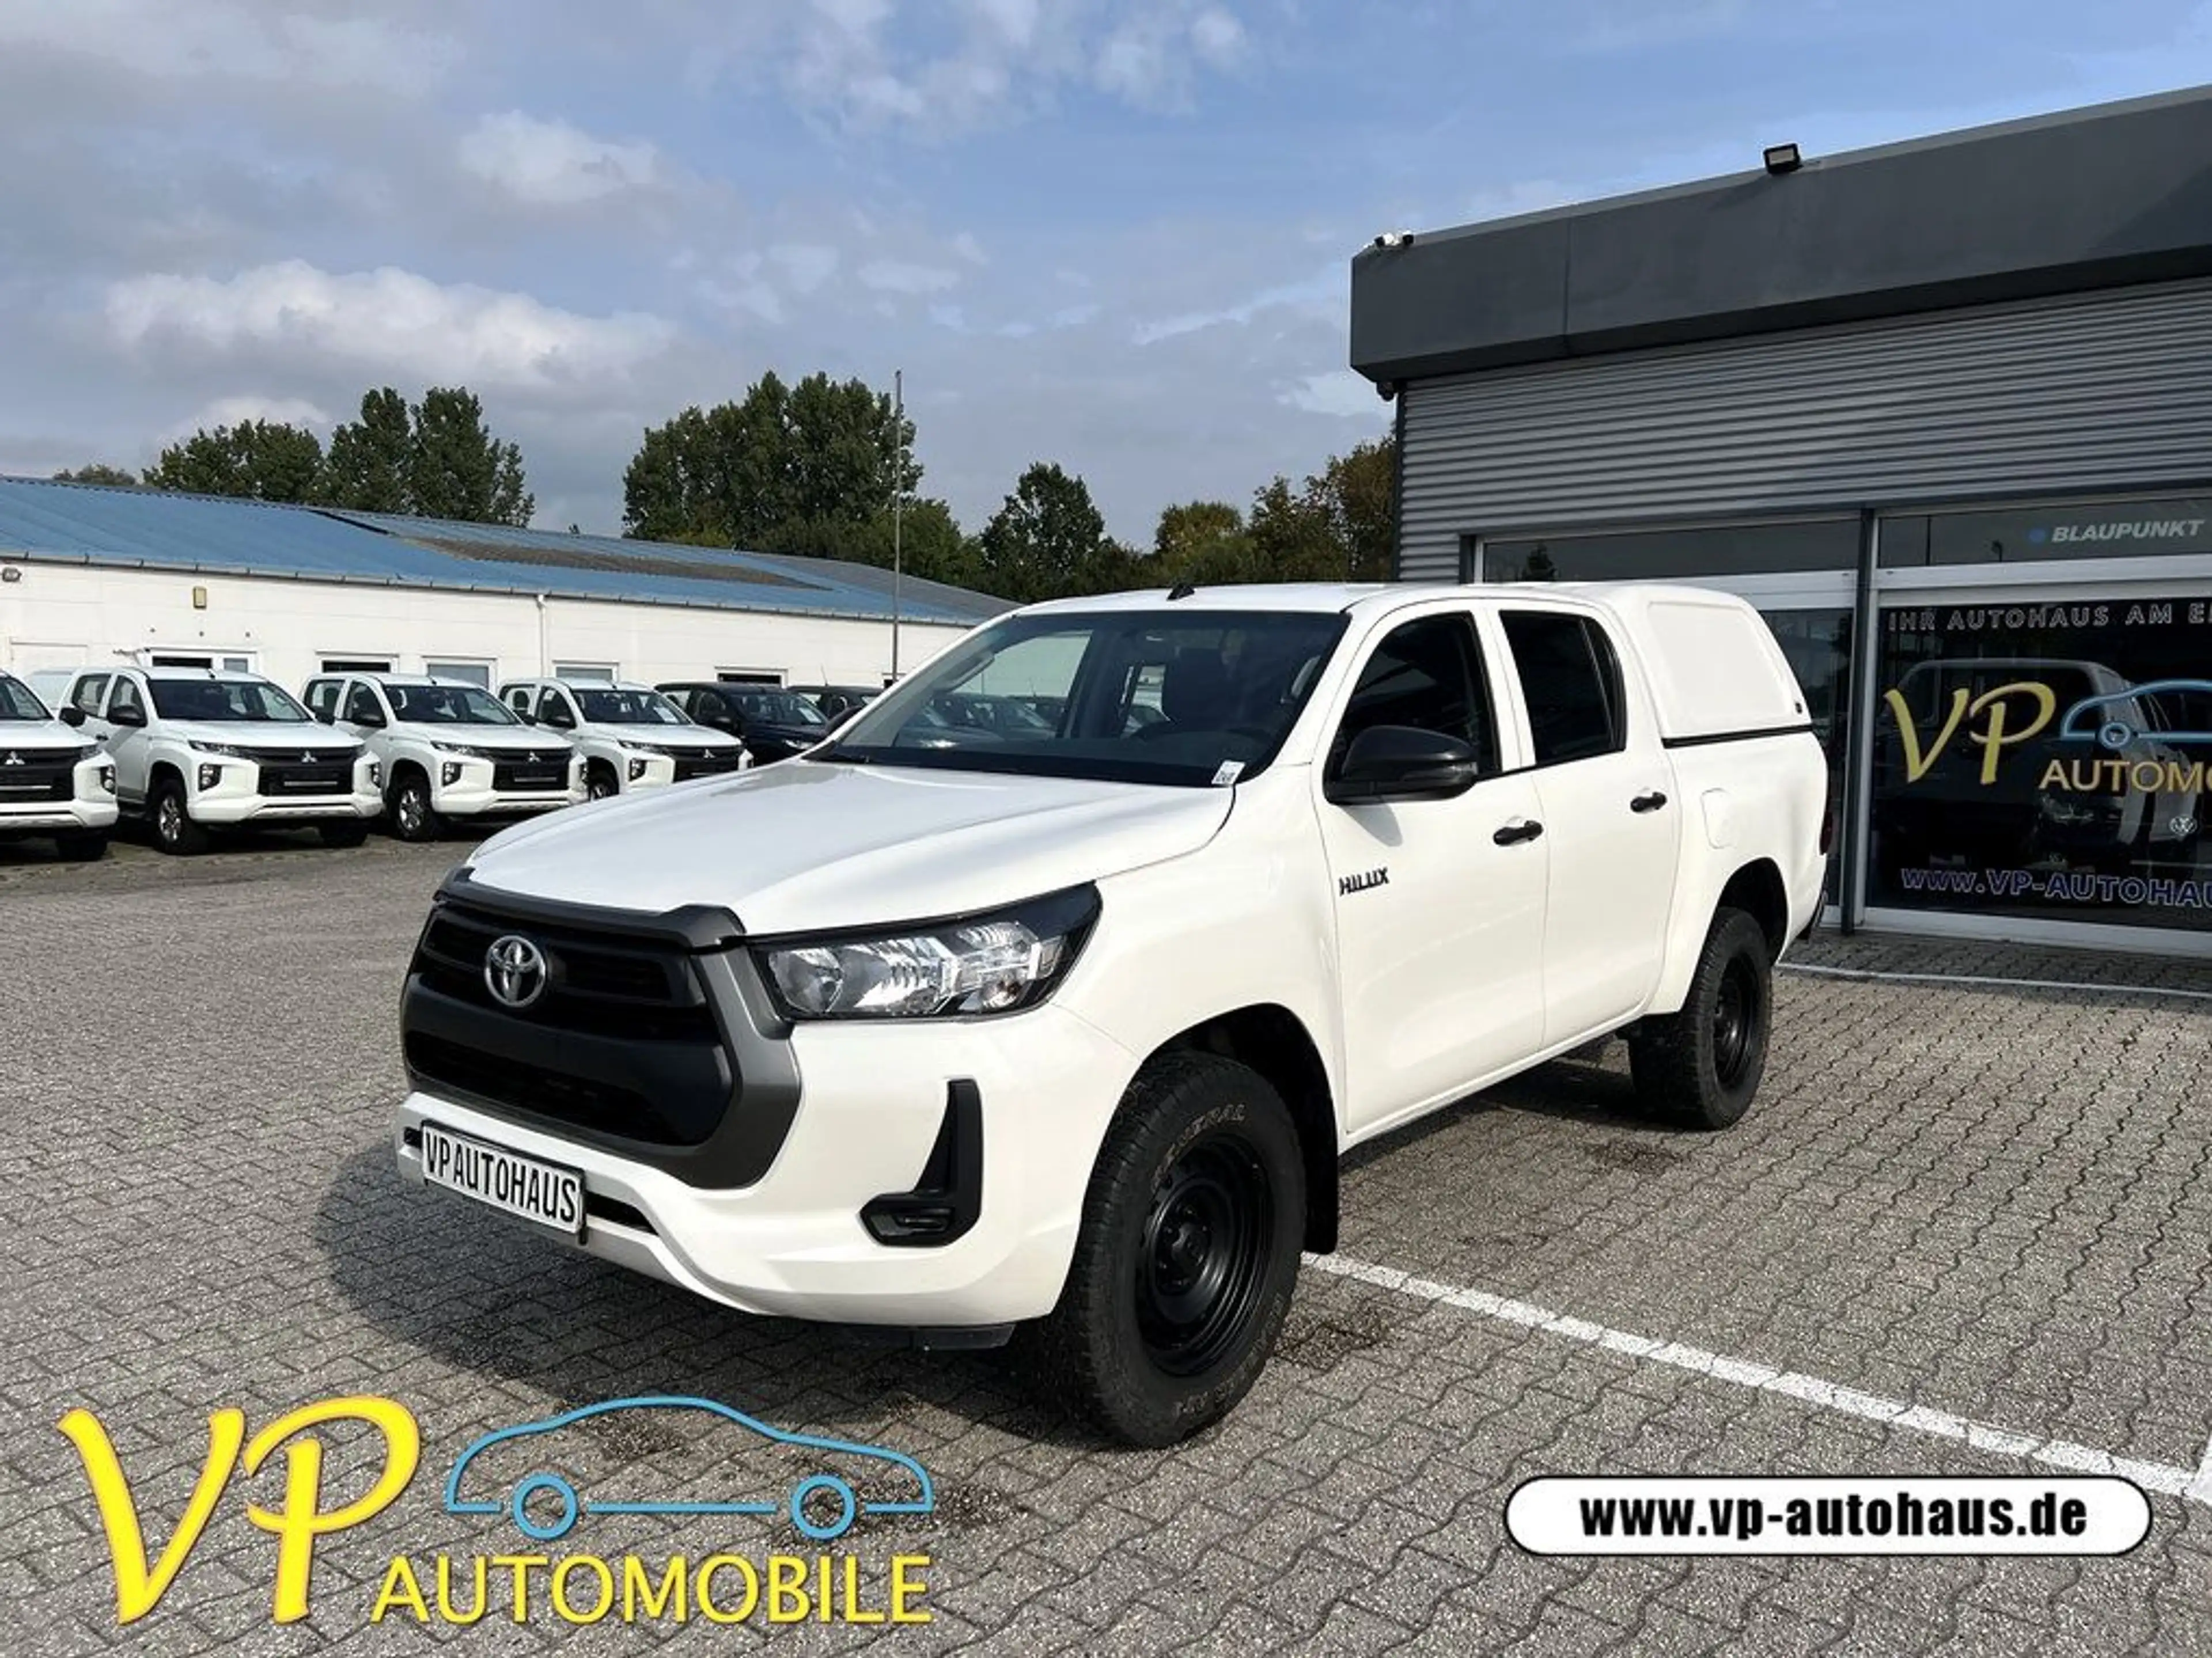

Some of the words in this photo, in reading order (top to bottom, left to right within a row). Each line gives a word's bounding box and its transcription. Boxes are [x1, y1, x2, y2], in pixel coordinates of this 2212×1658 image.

[2051, 520, 2205, 543] BLAUPUNKT
[1888, 610, 1937, 631] IHR
[1946, 605, 2109, 630] AUTOHAUS
[2124, 603, 2173, 625] AM
[2188, 602, 2212, 624] E
[1884, 682, 2056, 785] VP
[2038, 758, 2212, 794] AUTOM
[1338, 866, 1390, 897] HILUX
[426, 1132, 450, 1177] VP
[453, 1143, 577, 1223] AUTOHAUS
